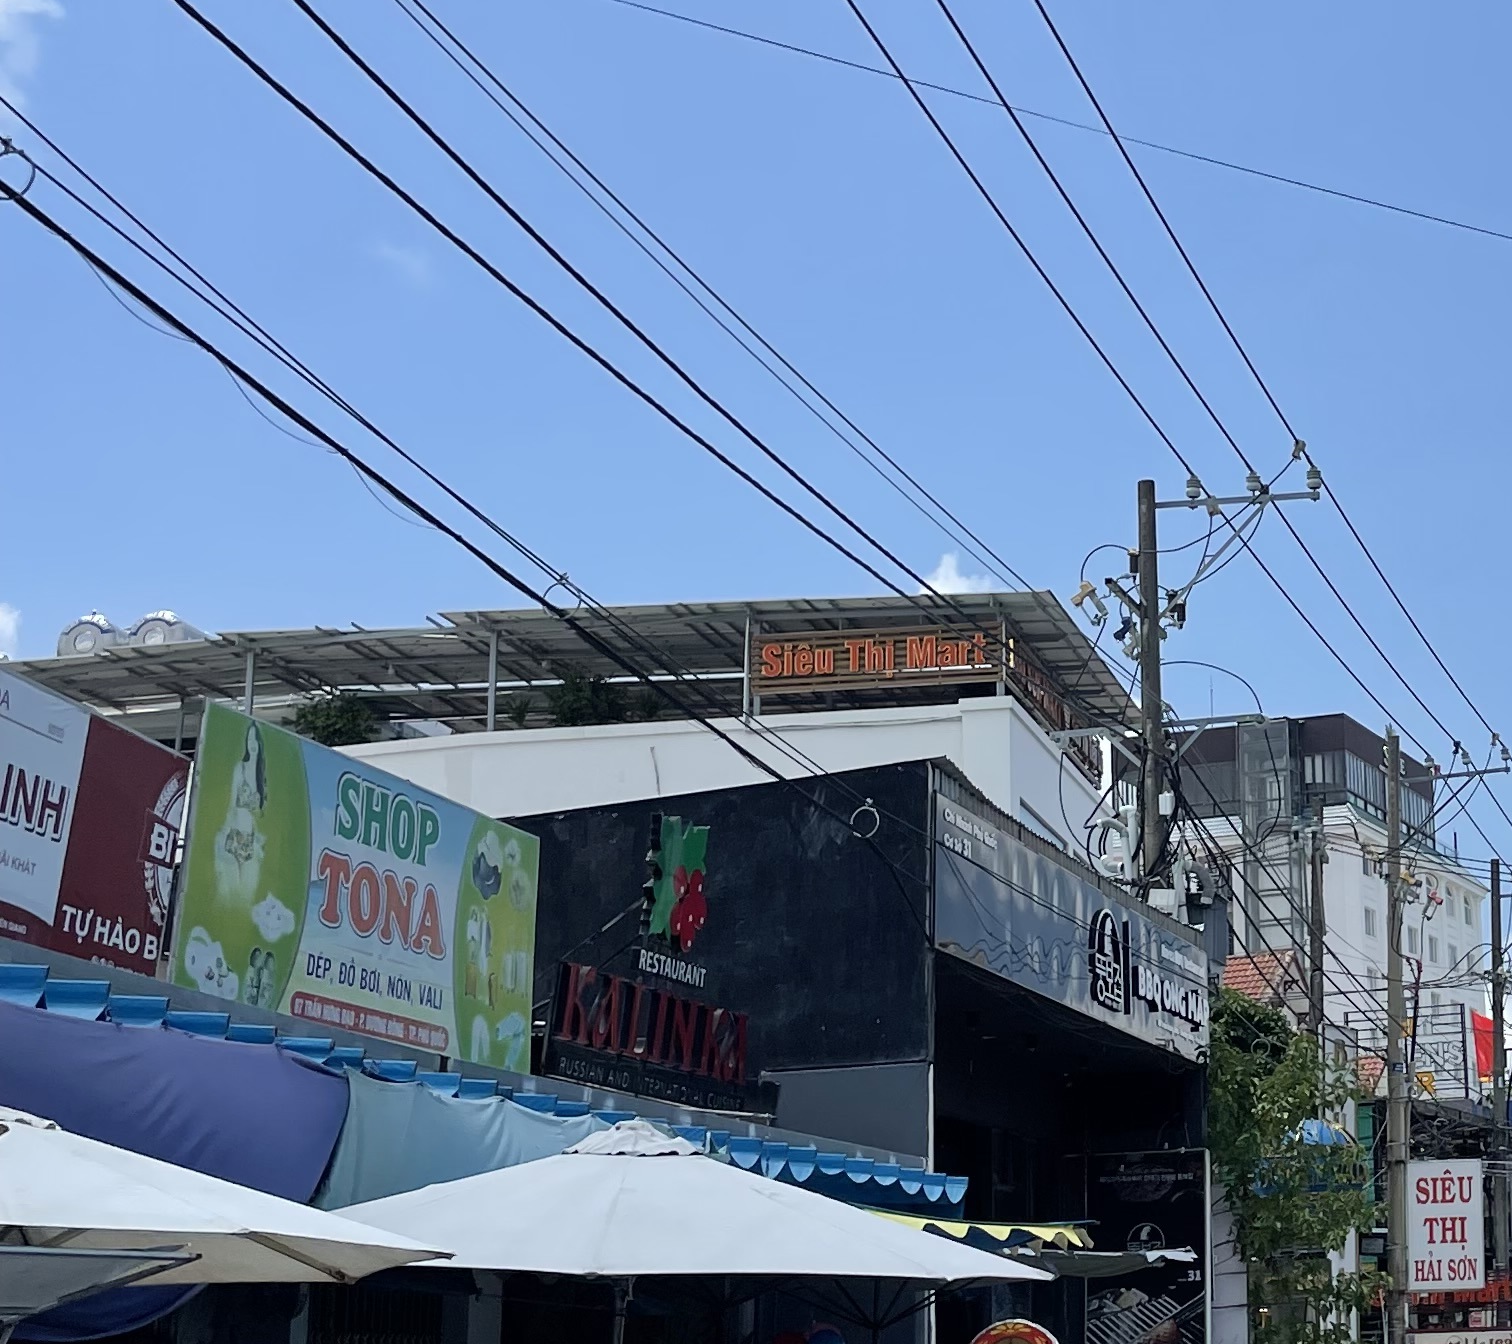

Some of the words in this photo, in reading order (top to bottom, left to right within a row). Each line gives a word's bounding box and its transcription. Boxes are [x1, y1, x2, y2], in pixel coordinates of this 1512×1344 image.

[761, 638, 834, 678] Siêu
[845, 637, 895, 678] Thị
[906, 633, 987, 670] Mart
[0, 764, 70, 843] INH
[334, 771, 440, 866] SHOP
[318, 847, 446, 961] TONA
[61, 905, 94, 944] TỰ
[93, 915, 140, 955] HÀO
[143, 934, 158, 961] B
[638, 948, 707, 988] RESTAURANT
[1138, 964, 1162, 1013] BBQ
[419, 983, 443, 1010] VALI
[556, 962, 749, 1085] KALINKA
[560, 1057, 604, 1082] RUSSIAN
[606, 1071, 630, 1088] AND
[1416, 1168, 1473, 1205] SIÊU
[1423, 1216, 1467, 1251] THỊ
[1187, 1270, 1202, 1282] 31
[1414, 1250, 1442, 1282] HẢI
[1447, 1255, 1478, 1281] SƠN
